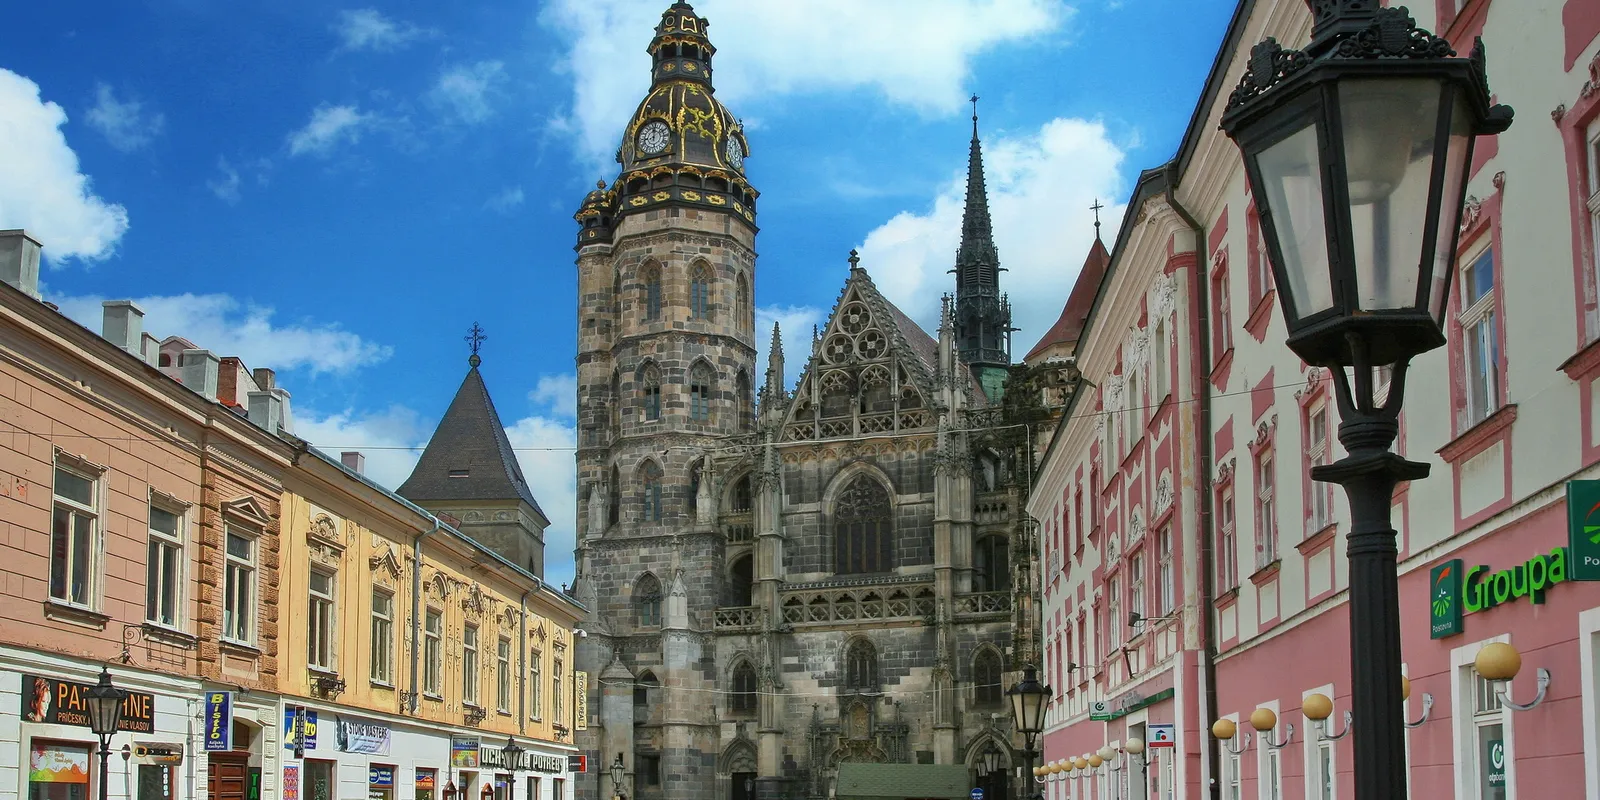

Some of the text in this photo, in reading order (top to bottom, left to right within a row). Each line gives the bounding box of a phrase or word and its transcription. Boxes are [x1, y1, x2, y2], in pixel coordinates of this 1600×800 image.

[1463, 547, 1565, 613] Groupa
[211, 693, 224, 739] Bistro
[365, 725, 388, 740] MASTERS
